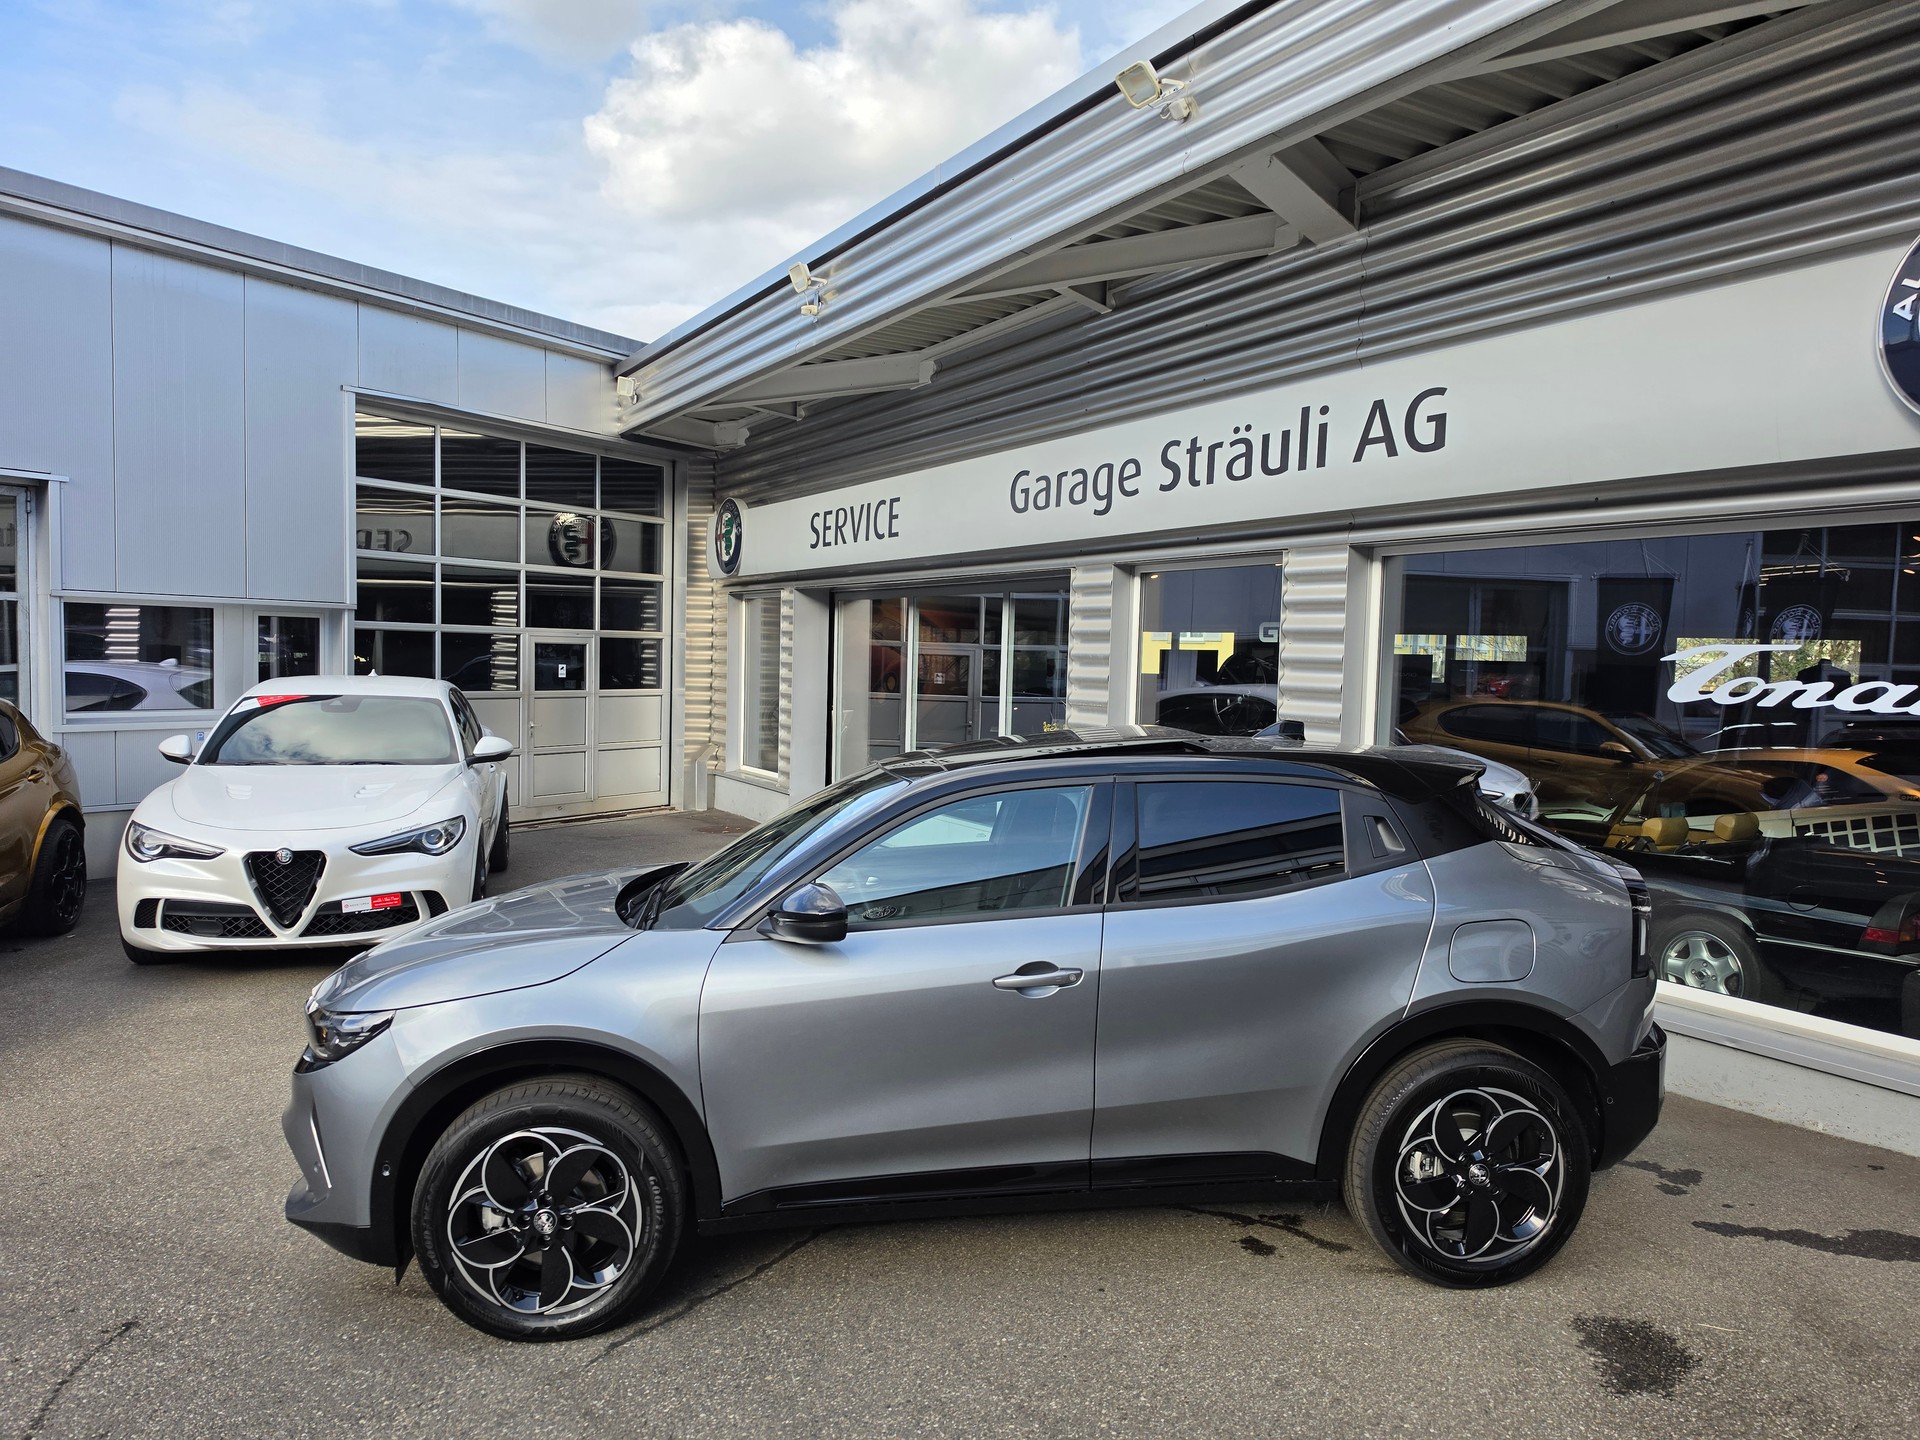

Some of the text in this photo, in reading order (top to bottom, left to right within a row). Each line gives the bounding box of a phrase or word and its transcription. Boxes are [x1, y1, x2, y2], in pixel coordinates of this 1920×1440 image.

[1010, 386, 1448, 516] Garage Sträuli AG
[810, 496, 901, 549] SERVICE
